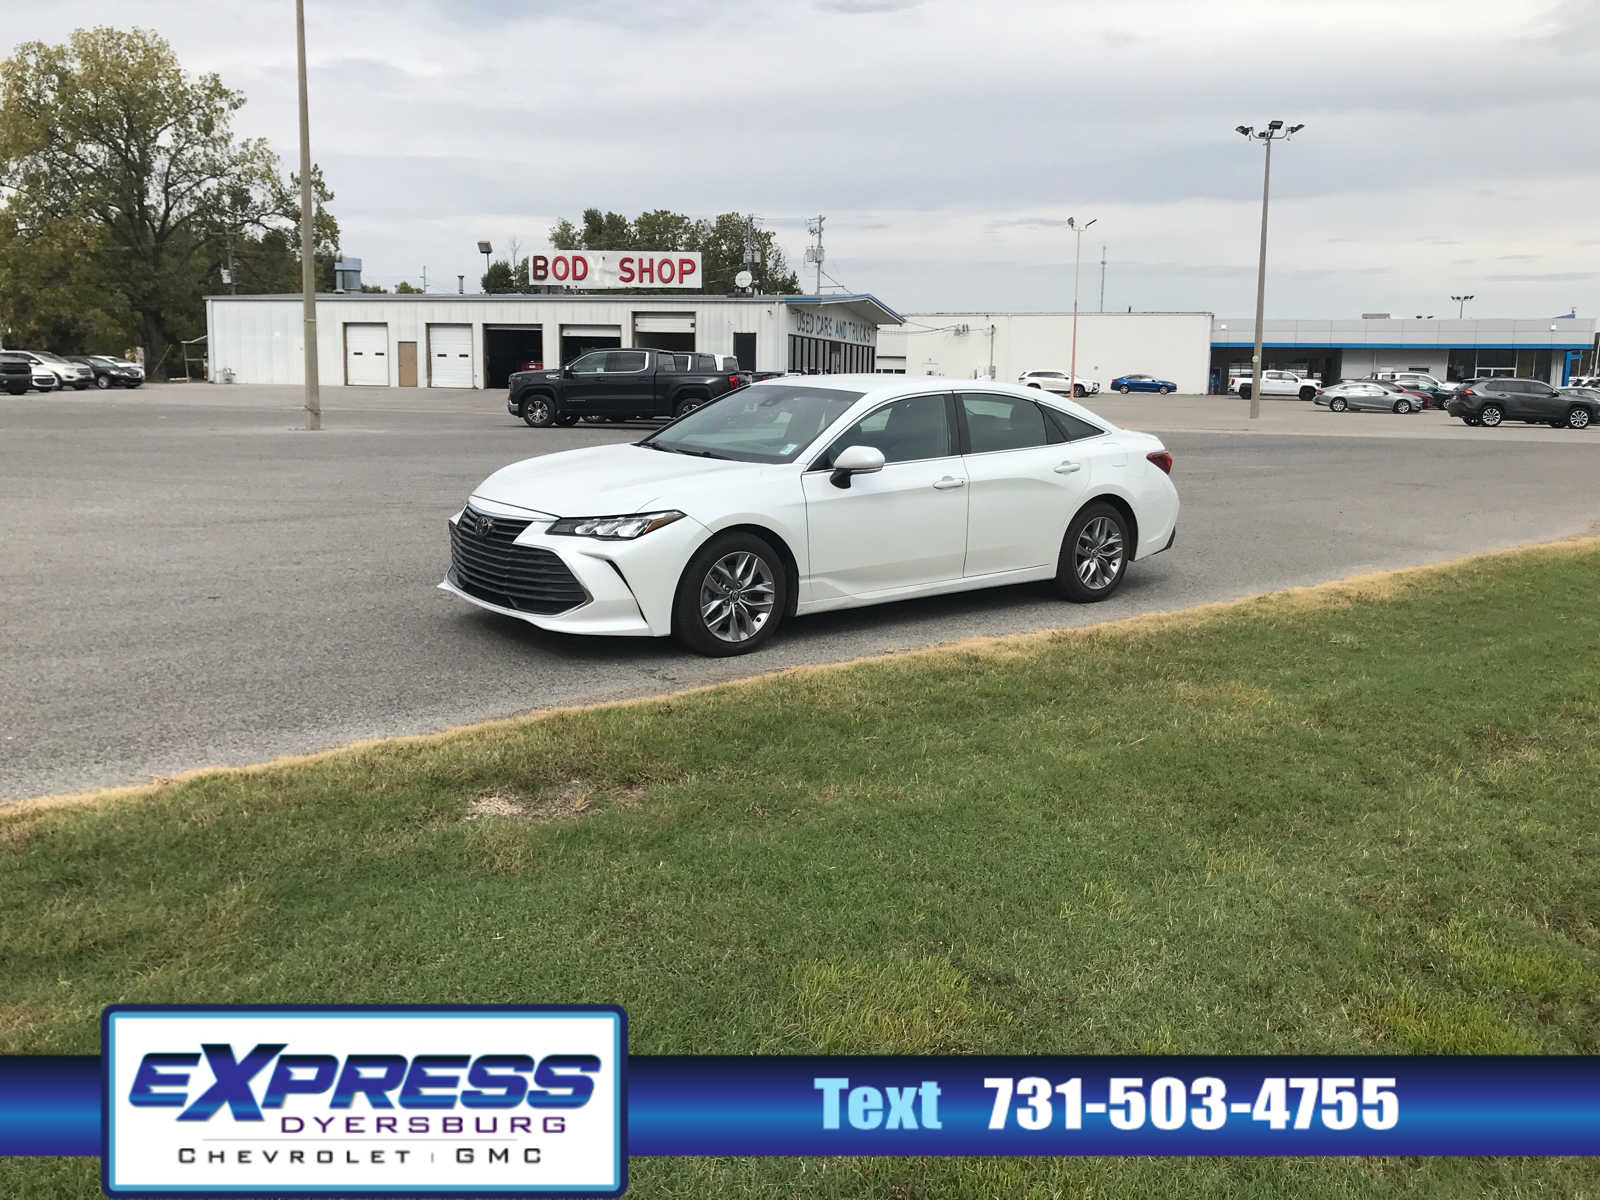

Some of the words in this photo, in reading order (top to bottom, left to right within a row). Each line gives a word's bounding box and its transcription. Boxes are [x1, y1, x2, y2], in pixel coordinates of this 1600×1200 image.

[618, 257, 696, 284] SHOP
[796, 311, 815, 334] USED
[815, 315, 833, 337] CARS
[848, 321, 871, 344] TRUCKS
